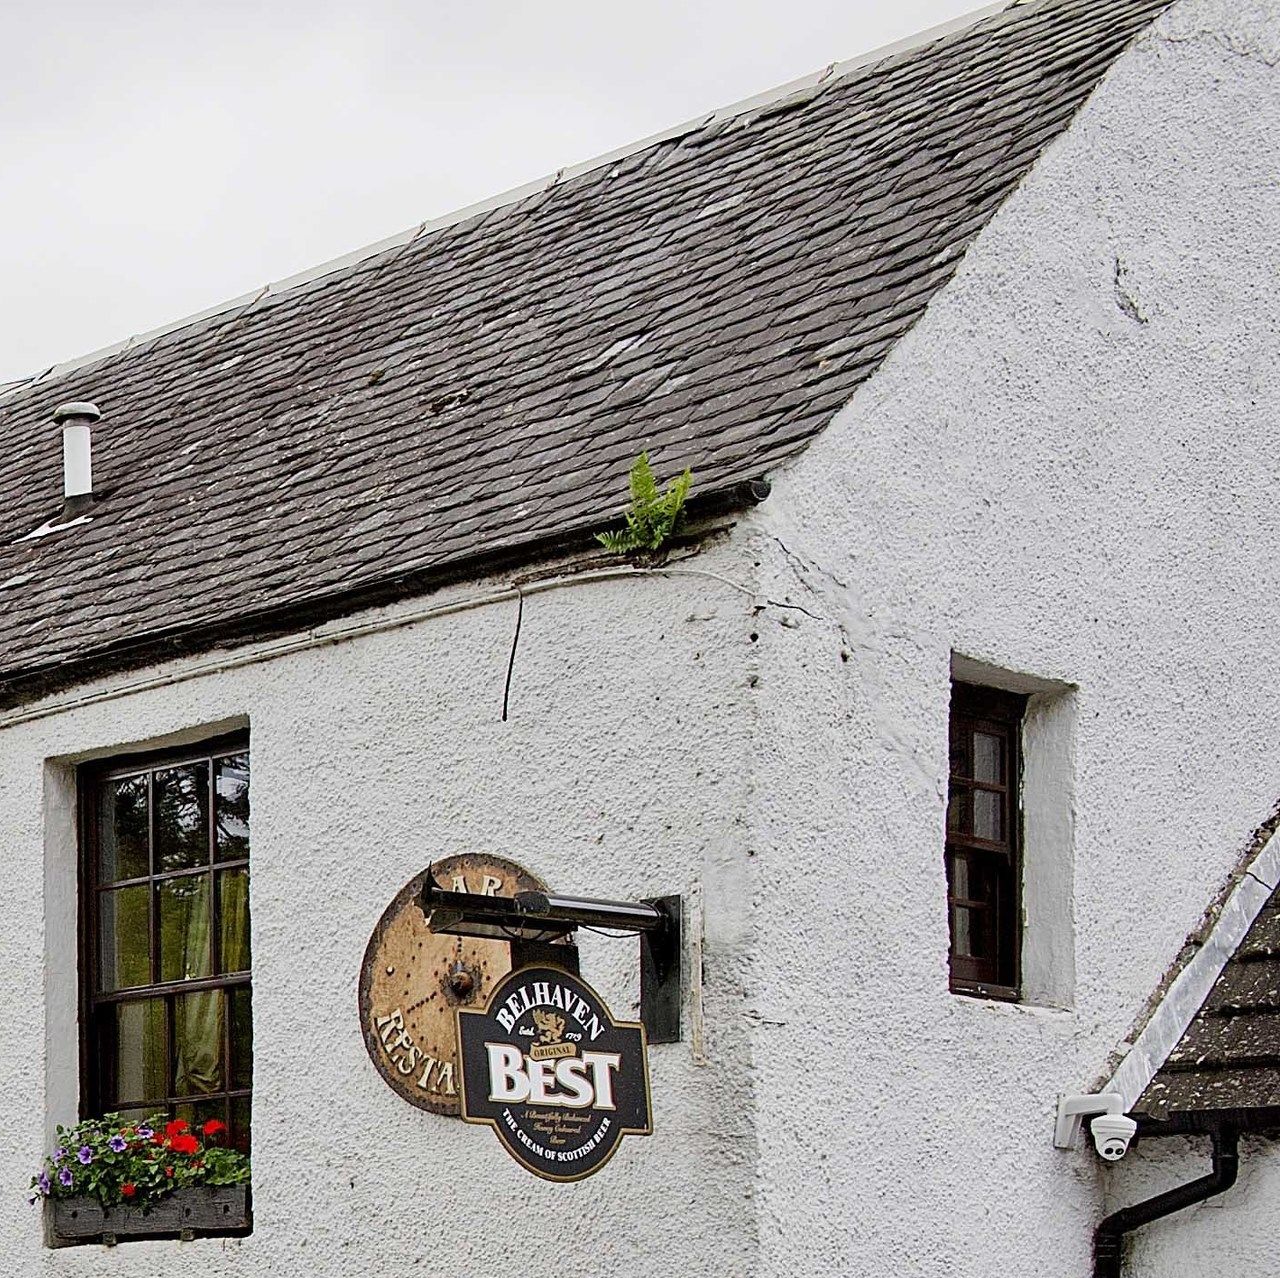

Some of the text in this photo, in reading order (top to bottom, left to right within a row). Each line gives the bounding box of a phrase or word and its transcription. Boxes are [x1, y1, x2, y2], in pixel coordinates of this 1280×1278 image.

[495, 982, 605, 1041] BELHAVEN
[374, 1008, 460, 1095] RESTA
[485, 1041, 622, 1111] BEST
[533, 1046, 572, 1057] ORIGINAL
[502, 1107, 612, 1162] THE CREAM OF SCOTTISH BEER
